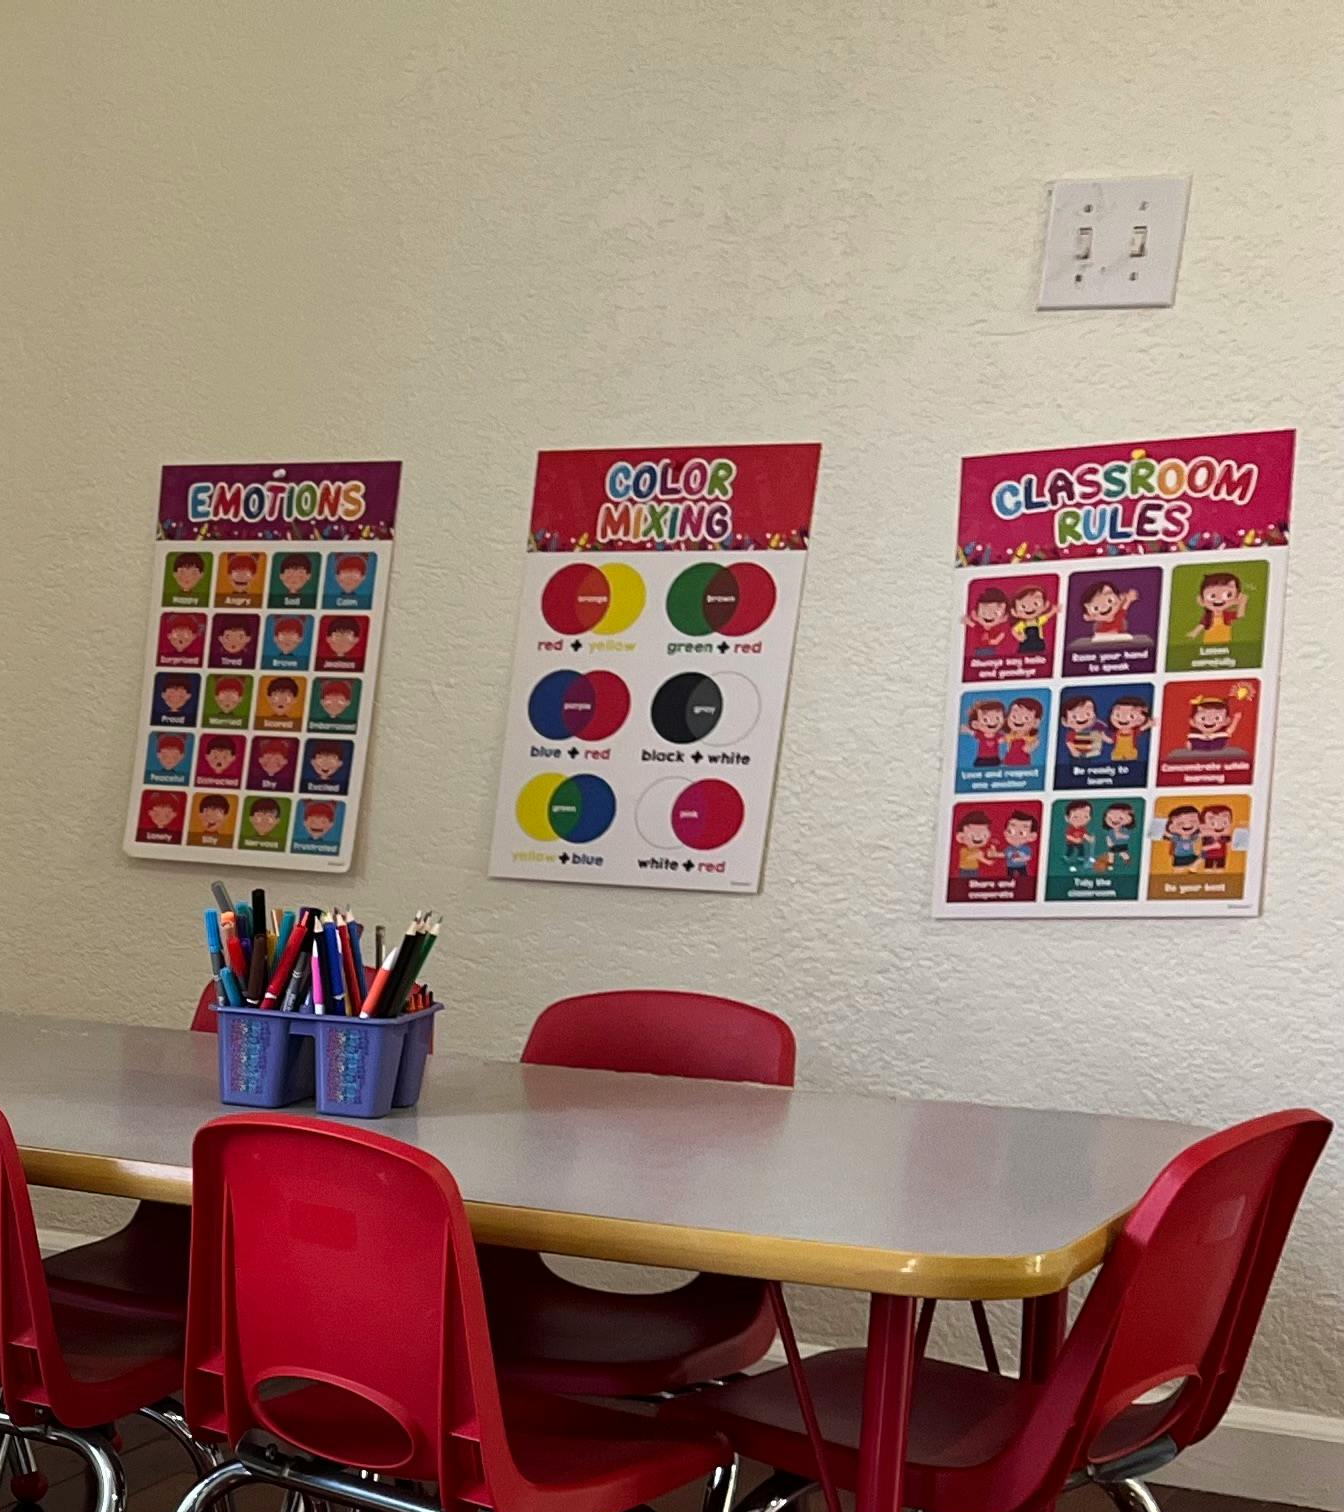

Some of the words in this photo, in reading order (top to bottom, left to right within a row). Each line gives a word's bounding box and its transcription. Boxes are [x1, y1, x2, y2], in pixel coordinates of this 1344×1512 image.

[606, 457, 737, 501] COLOR
[992, 456, 1259, 520] CLASSROOM
[188, 480, 367, 523] EMOTIONS
[596, 501, 732, 544] MIXING
[1054, 501, 1193, 547] RULES
[537, 640, 563, 651] red
[588, 641, 636, 654] yellow
[667, 642, 712, 656] green
[734, 642, 762, 654] red
[530, 746, 561, 758] blue
[584, 749, 611, 760] red
[641, 749, 685, 763] black
[707, 752, 751, 765] white
[571, 853, 603, 866] blue
[637, 858, 679, 870] white
[697, 861, 725, 873] red
